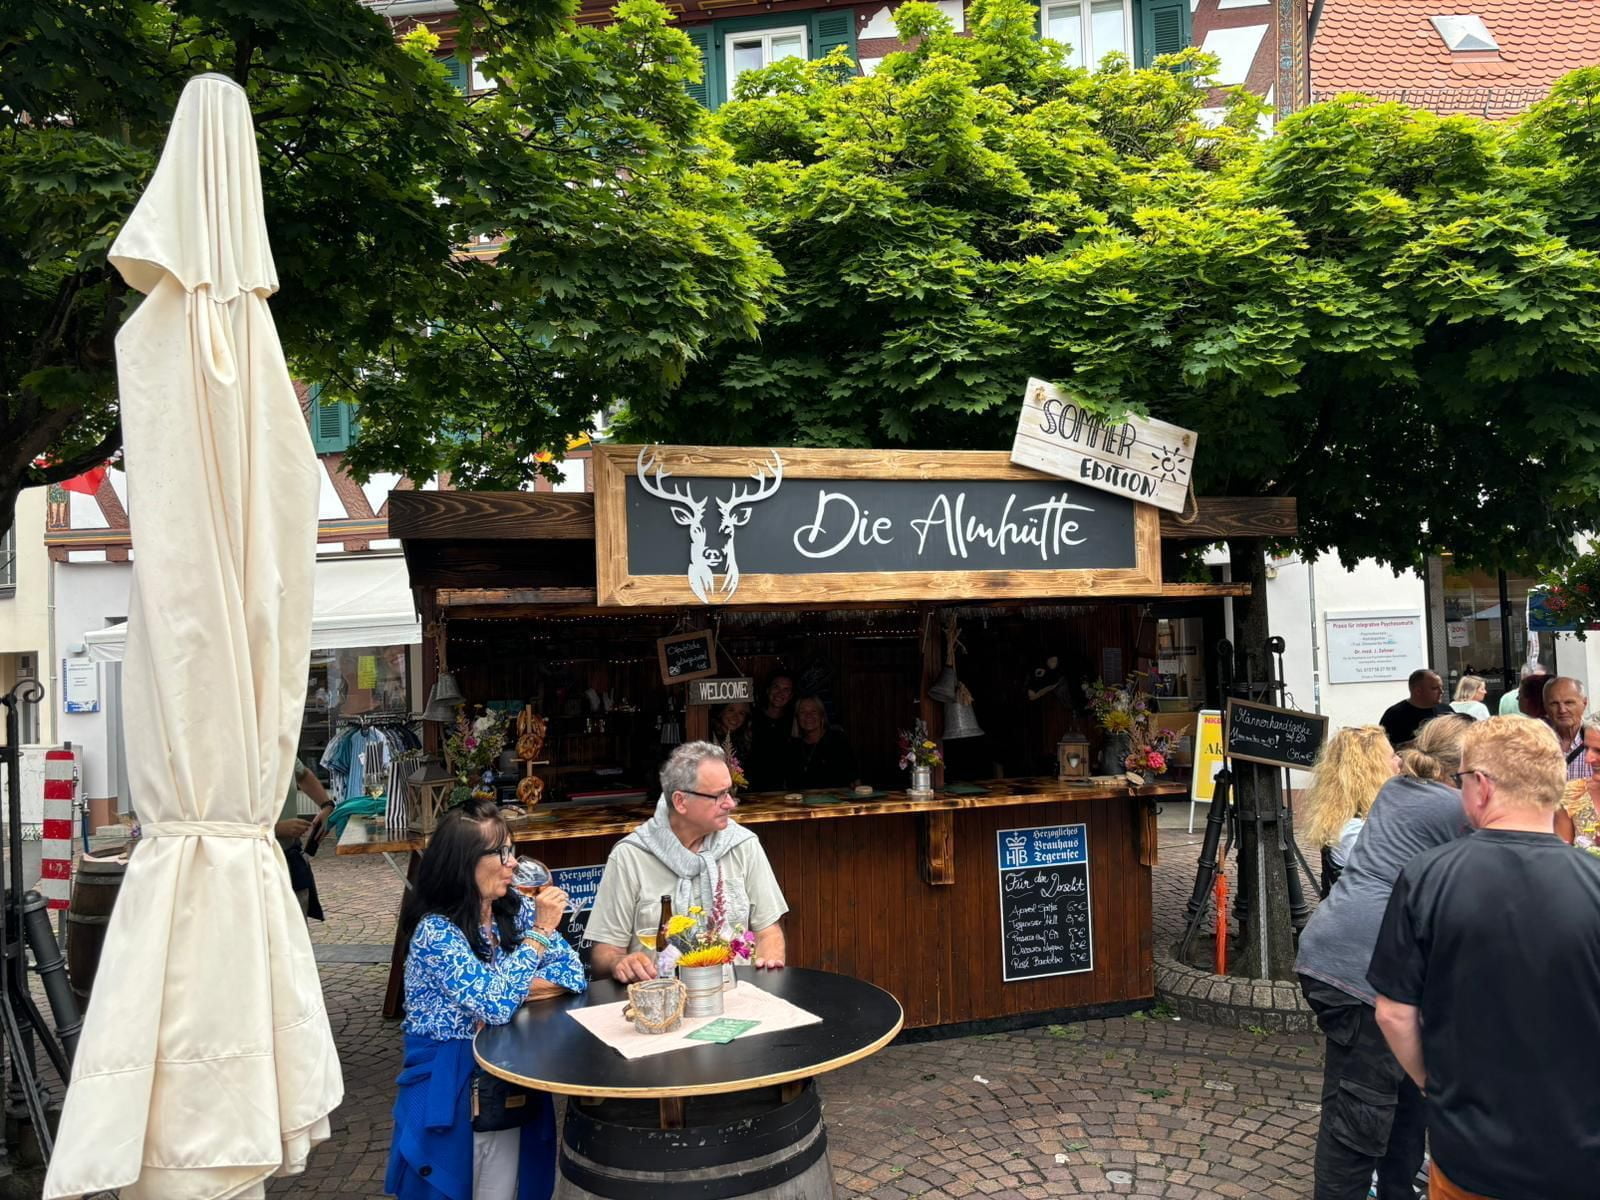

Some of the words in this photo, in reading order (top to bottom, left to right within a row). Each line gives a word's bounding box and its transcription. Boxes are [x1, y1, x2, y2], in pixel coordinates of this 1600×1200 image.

[1040, 399, 1136, 459] SOMMER
[793, 490, 895, 559] Die
[910, 492, 1096, 561] Almhütte
[699, 681, 749, 700] WELCOME
[1204, 743, 1224, 755] Ak
[1033, 827, 1079, 840] Herzogliches
[1033, 838, 1079, 851] Brauhaus
[1034, 850, 1079, 863] Tegernsee
[560, 881, 600, 894] Brauh
[1005, 871, 1034, 892] Für
[1041, 873, 1086, 898] Dorscht
